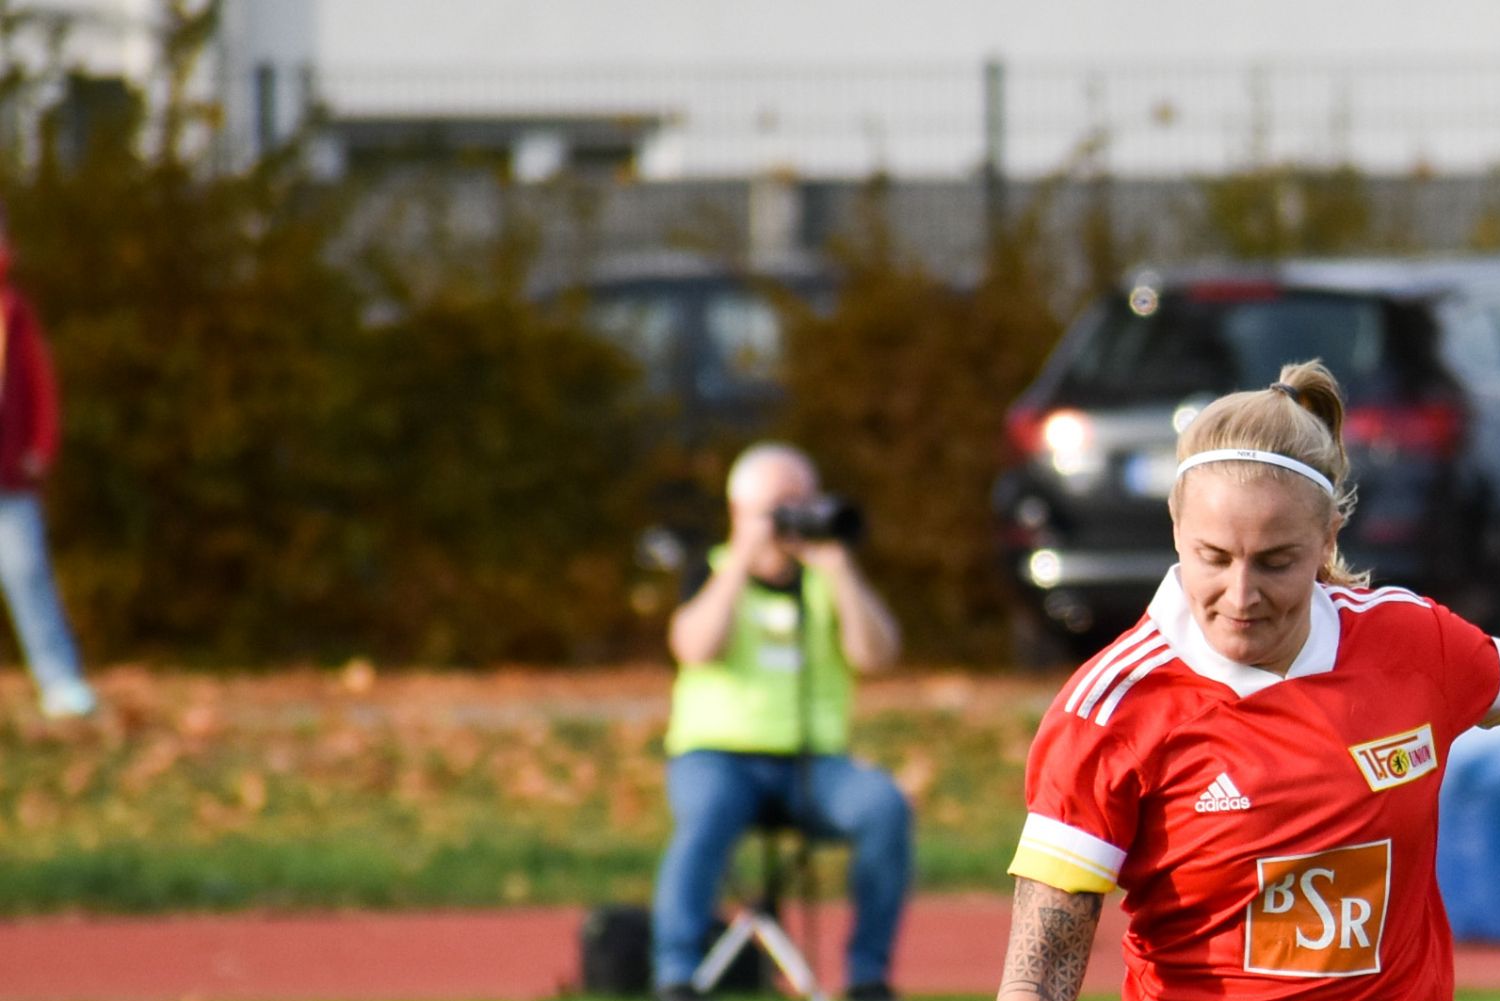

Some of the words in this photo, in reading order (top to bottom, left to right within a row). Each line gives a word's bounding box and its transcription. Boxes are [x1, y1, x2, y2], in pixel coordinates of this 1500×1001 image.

[1237, 450, 1257, 459] NIKE
[1194, 796, 1251, 813] adidas
[1262, 867, 1371, 951] BSR
